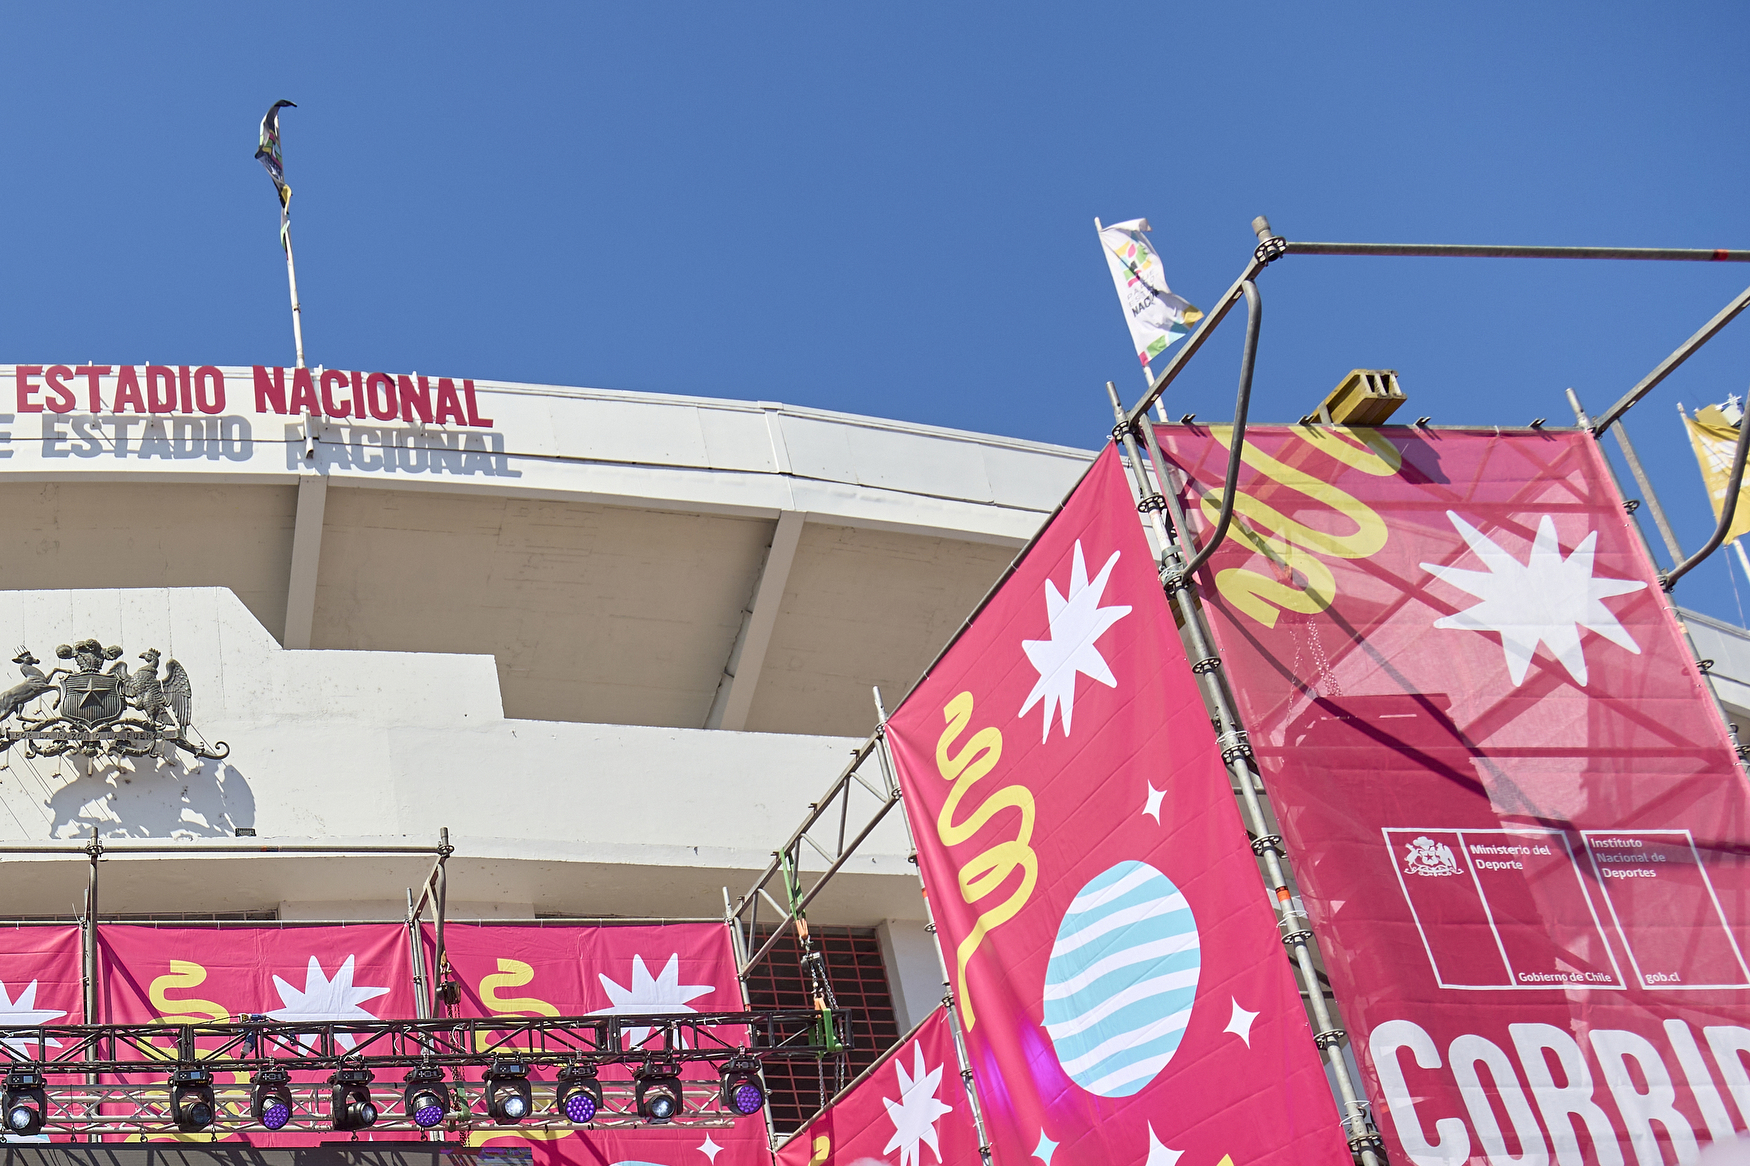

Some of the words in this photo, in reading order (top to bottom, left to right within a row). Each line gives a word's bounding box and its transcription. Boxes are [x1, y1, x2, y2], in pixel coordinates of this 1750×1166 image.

[16, 365, 226, 415] ESTADIO
[253, 365, 493, 428] NACIONAL
[1591, 838, 1643, 849] Instituto
[1470, 844, 1530, 856] Ministerio
[1533, 845, 1552, 856] del
[1596, 852, 1649, 863] Nacional
[1651, 852, 1666, 863] de
[1476, 859, 1524, 872] Deporte
[1602, 867, 1657, 880] Deportes
[1518, 972, 1568, 983] Gobierno
[1569, 972, 1584, 983] de
[1585, 972, 1612, 983] Chile
[1645, 972, 1681, 984] gob.cl
